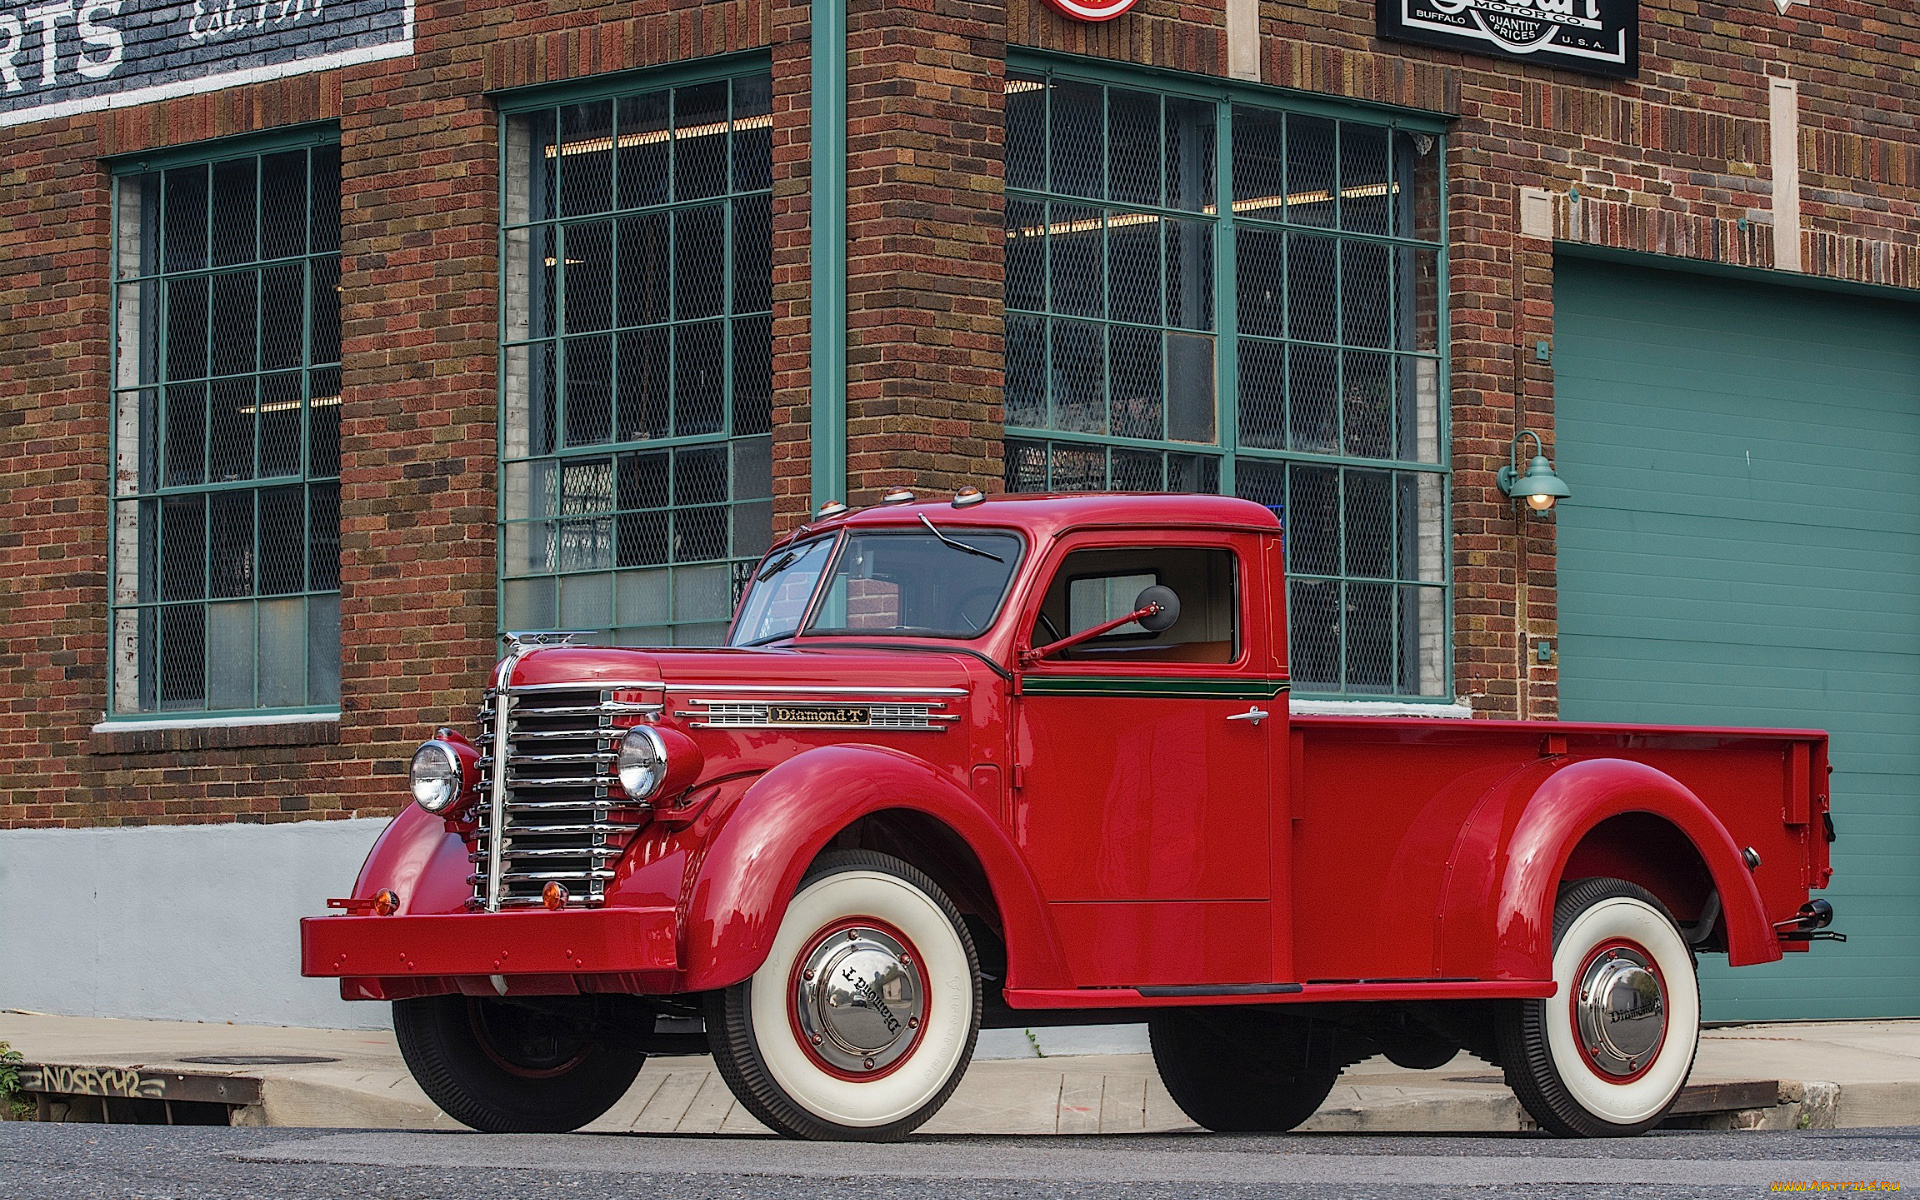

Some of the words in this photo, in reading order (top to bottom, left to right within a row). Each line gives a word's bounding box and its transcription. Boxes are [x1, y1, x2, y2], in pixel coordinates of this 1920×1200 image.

[1416, 9, 1466, 25] BUFFALO
[1474, 1, 1548, 20] MOTOR
[1552, 14, 1585, 27] CO.
[1489, 14, 1541, 31] QUANTITY
[1493, 24, 1536, 41] PRICES
[776, 708, 847, 722] Diamond
[847, 709, 863, 722] T
[853, 977, 902, 1036] Diamond
